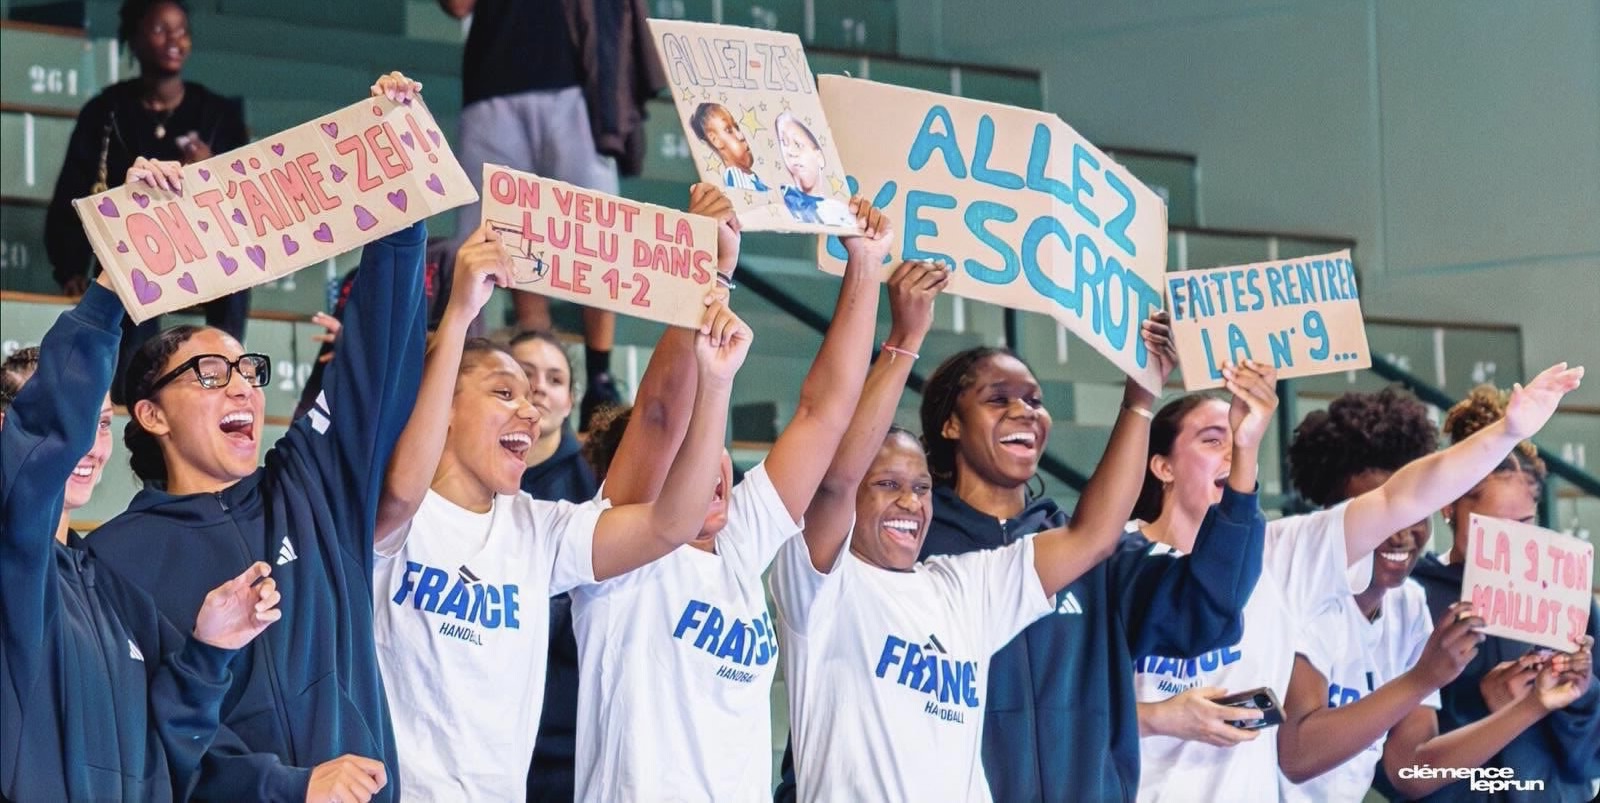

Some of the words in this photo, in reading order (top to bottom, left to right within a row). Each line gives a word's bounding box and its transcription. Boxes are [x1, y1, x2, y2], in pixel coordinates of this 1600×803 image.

[29, 64, 78, 96] 261
[490, 171, 540, 209] ON
[552, 187, 640, 232] VEUT
[655, 213, 694, 247] LA
[908, 105, 1137, 257] ALLEZ
[126, 206, 207, 276] ON
[522, 212, 619, 263] LULU
[633, 239, 712, 285] DANS
[551, 255, 592, 294] LE
[601, 268, 650, 307] 1-2
[1265, 259, 1359, 307] RENTRER
[1201, 323, 1253, 379] LA
[1303, 310, 1358, 360] 9...
[1475, 527, 1510, 575] LA
[1547, 545, 1587, 591] TON
[925, 701, 964, 724] HADBALL
